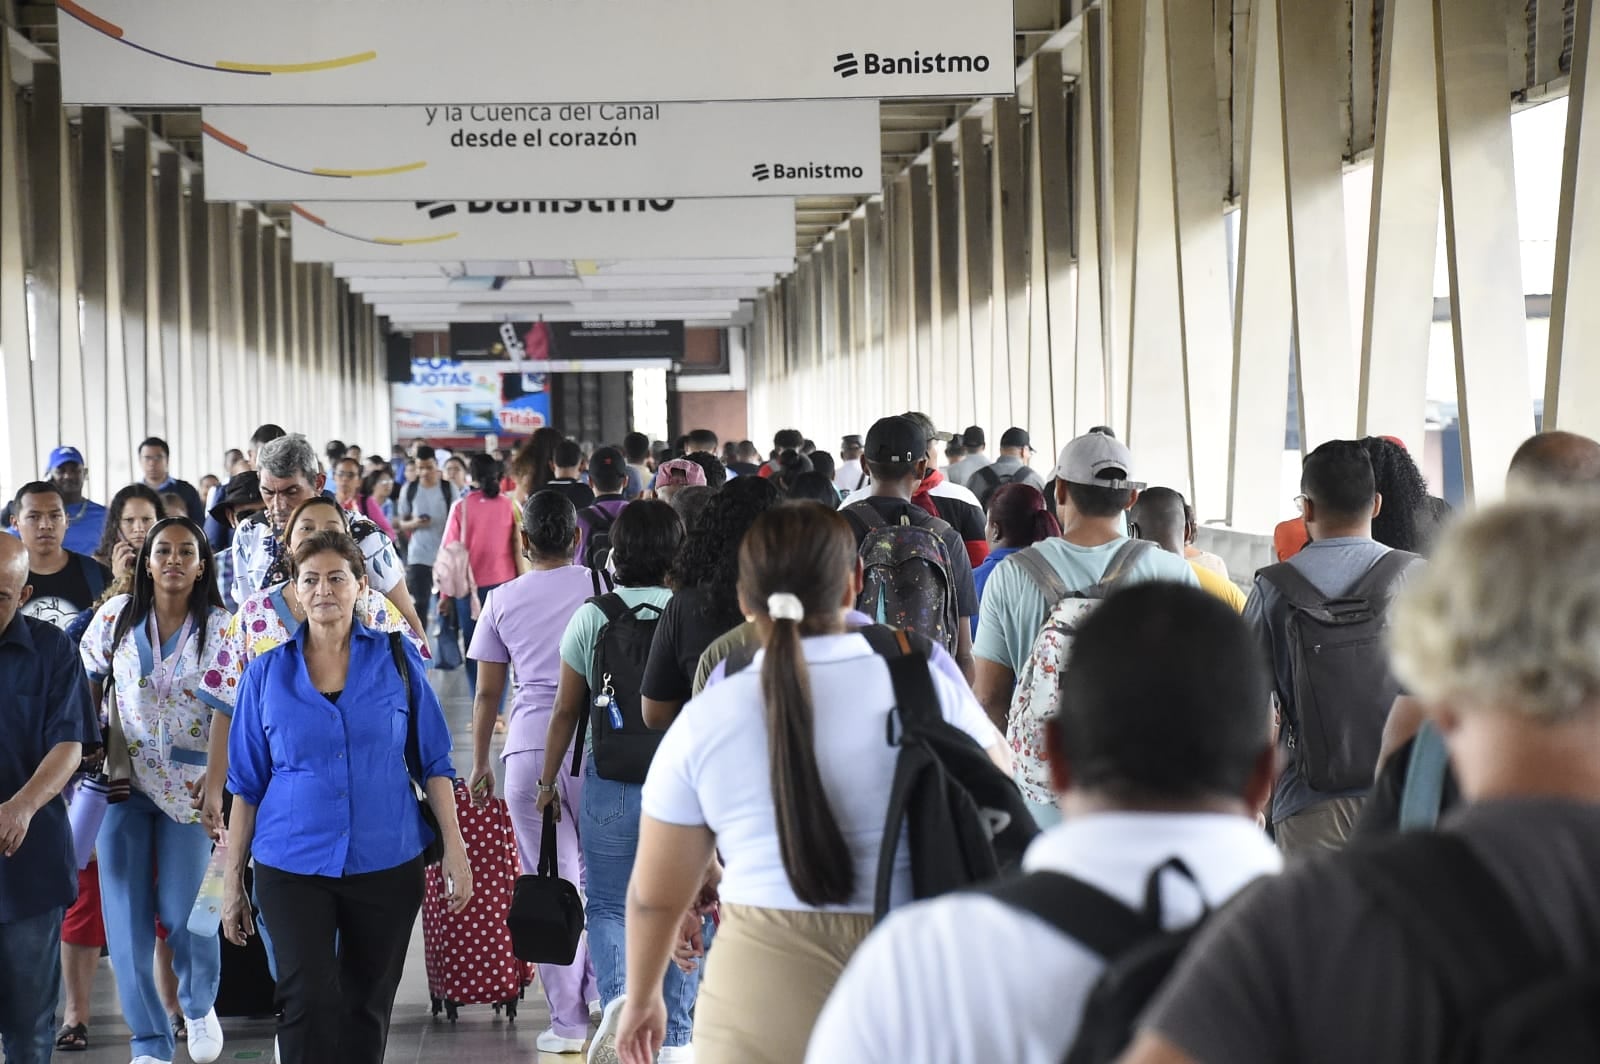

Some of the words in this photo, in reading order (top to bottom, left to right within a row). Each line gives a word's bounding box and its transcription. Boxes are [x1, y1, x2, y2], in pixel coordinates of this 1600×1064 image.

[864, 50, 990, 75] Banistmo
[426, 106, 438, 126] y
[445, 105, 463, 122] la
[471, 104, 552, 122] Cuenca
[559, 104, 592, 122] del
[600, 103, 661, 121] Canal
[451, 128, 517, 147] desde
[523, 128, 542, 147] el
[549, 126, 637, 147] corazón
[773, 162, 864, 179] Banistmo
[404, 373, 472, 386] UOTAS
